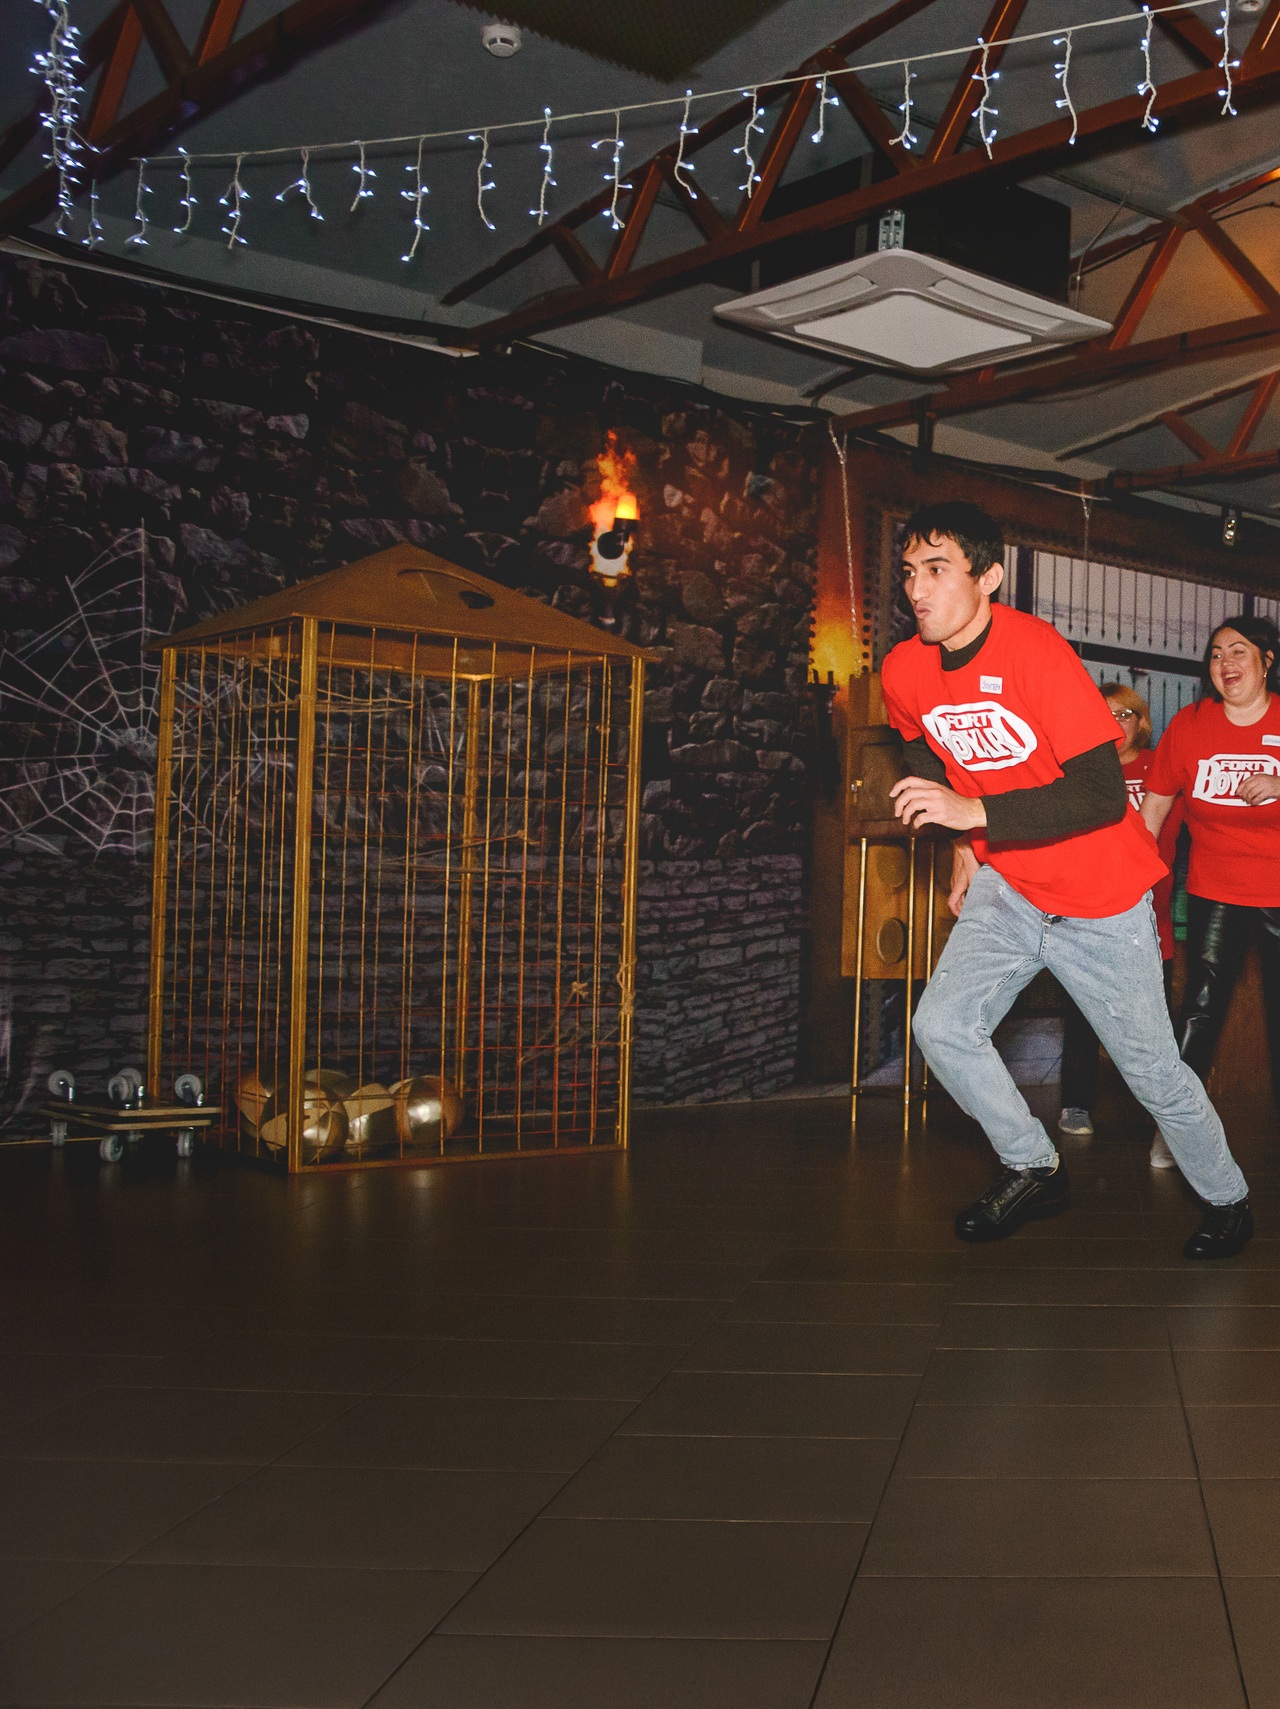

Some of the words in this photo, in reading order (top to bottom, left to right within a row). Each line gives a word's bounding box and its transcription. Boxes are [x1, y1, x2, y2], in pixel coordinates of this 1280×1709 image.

[945, 712, 993, 731] FORT
[921, 708, 1037, 766] BOYARD
[1220, 761, 1264, 772] FORT
